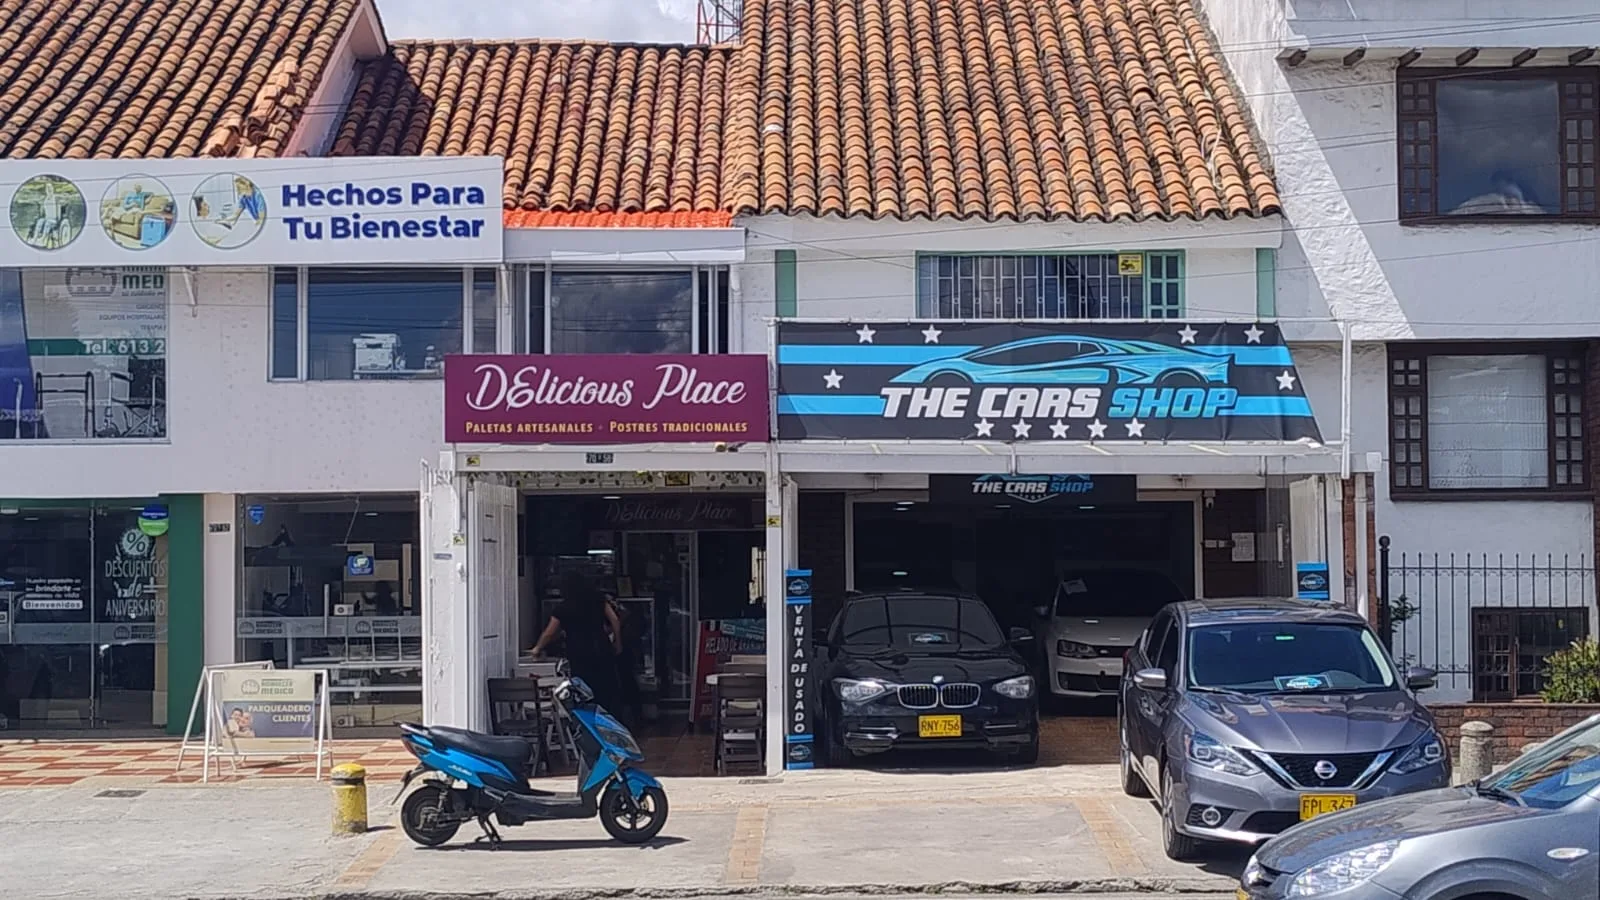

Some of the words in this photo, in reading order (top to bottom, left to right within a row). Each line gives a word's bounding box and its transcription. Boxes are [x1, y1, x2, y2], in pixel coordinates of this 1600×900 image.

[282, 183, 403, 207] Hechos
[411, 182, 485, 205] Para
[282, 217, 323, 240] Tu
[331, 213, 485, 239] Bienestar
[83, 339, 113, 354] Tel.
[118, 340, 150, 354] 613
[154, 340, 165, 353] 2
[642, 364, 747, 409] Place
[881, 387, 970, 418] THE
[976, 387, 1101, 418] CARS
[1108, 387, 1238, 418] SHOP
[465, 421, 513, 433] PALETAS
[517, 422, 593, 433] ARTESANALES
[609, 421, 658, 432] POSTRES
[662, 421, 748, 432] TRADICIONALES
[972, 481, 1003, 493] THE
[1004, 481, 1048, 493] CARS
[1049, 481, 1094, 493] SHOP
[105, 560, 165, 578] DESCUENTOS
[25, 601, 80, 609] Bienvenidos
[105, 599, 165, 617] ANIVERSARIO
[794, 605, 804, 658] VENTA
[790, 663, 808, 673] DE
[248, 704, 312, 713] PARQUEADERO
[794, 677, 805, 733] USADO
[272, 714, 312, 723] CLIENTES
